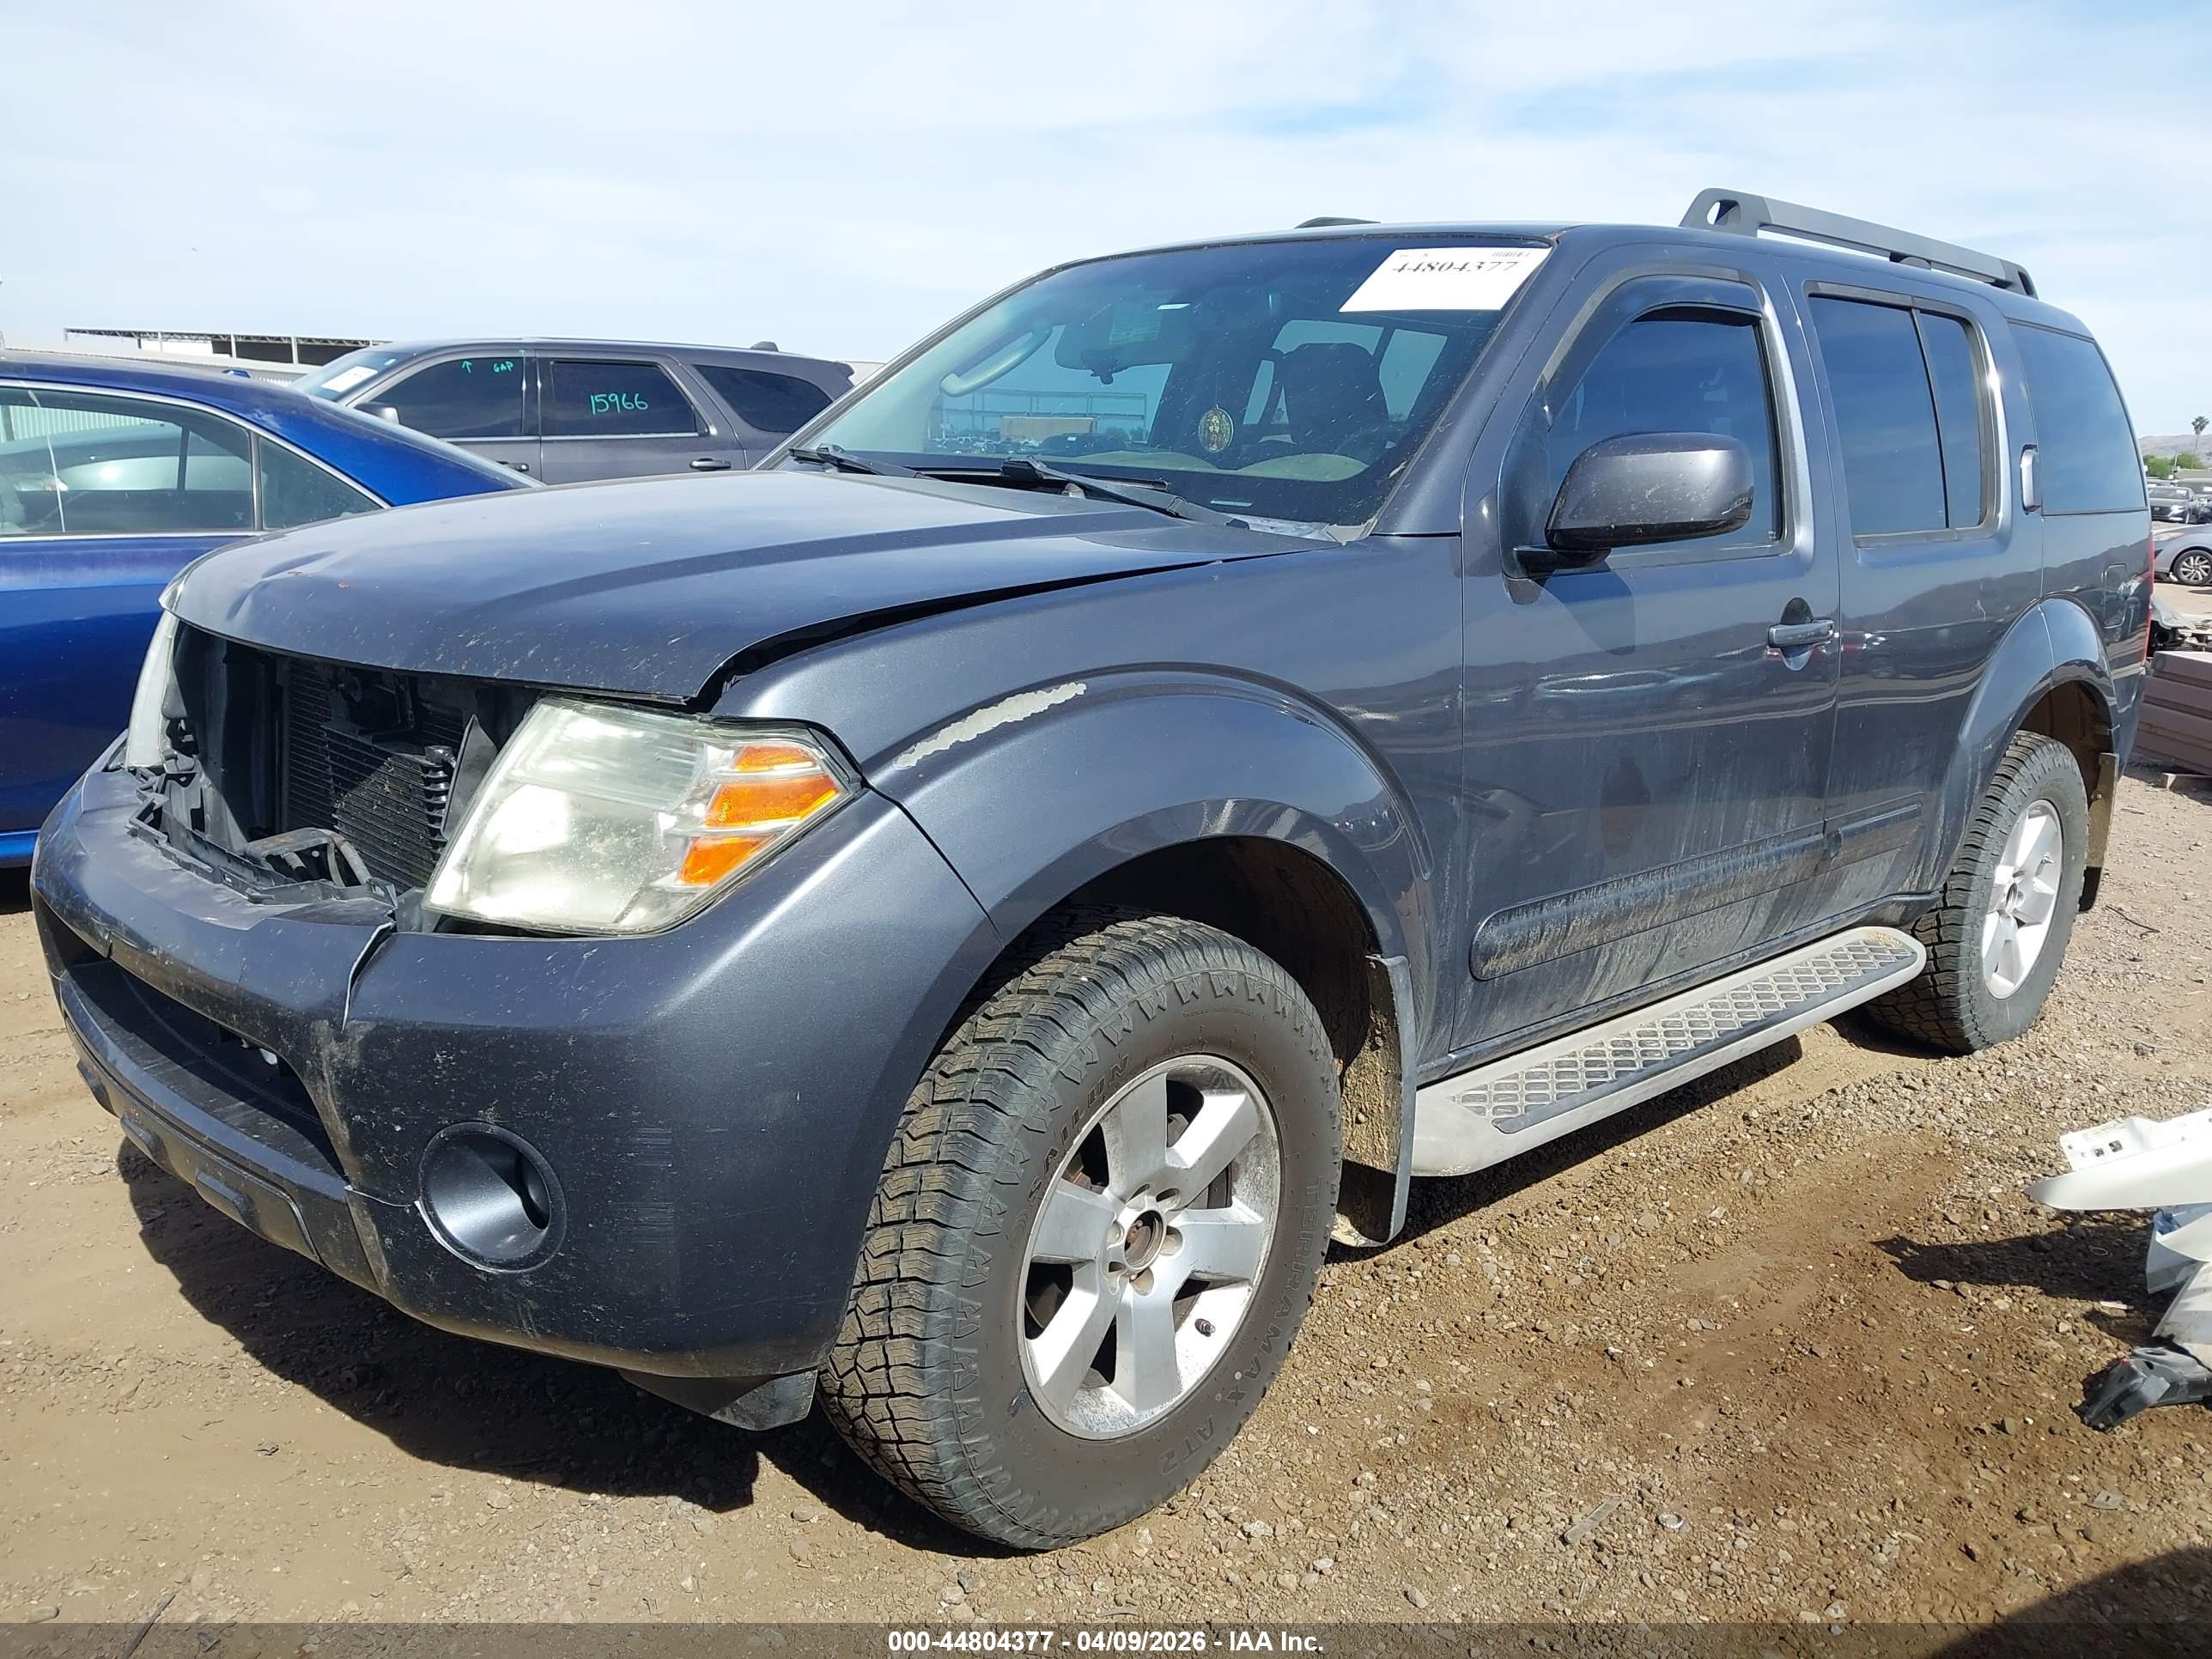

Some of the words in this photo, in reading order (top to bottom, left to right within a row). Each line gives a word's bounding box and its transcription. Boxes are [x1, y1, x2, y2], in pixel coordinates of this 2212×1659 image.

[1392, 261, 1519, 275] 44804377
[590, 393, 648, 415] 15966
[1224, 1176, 1324, 1407] TERRAMAX
